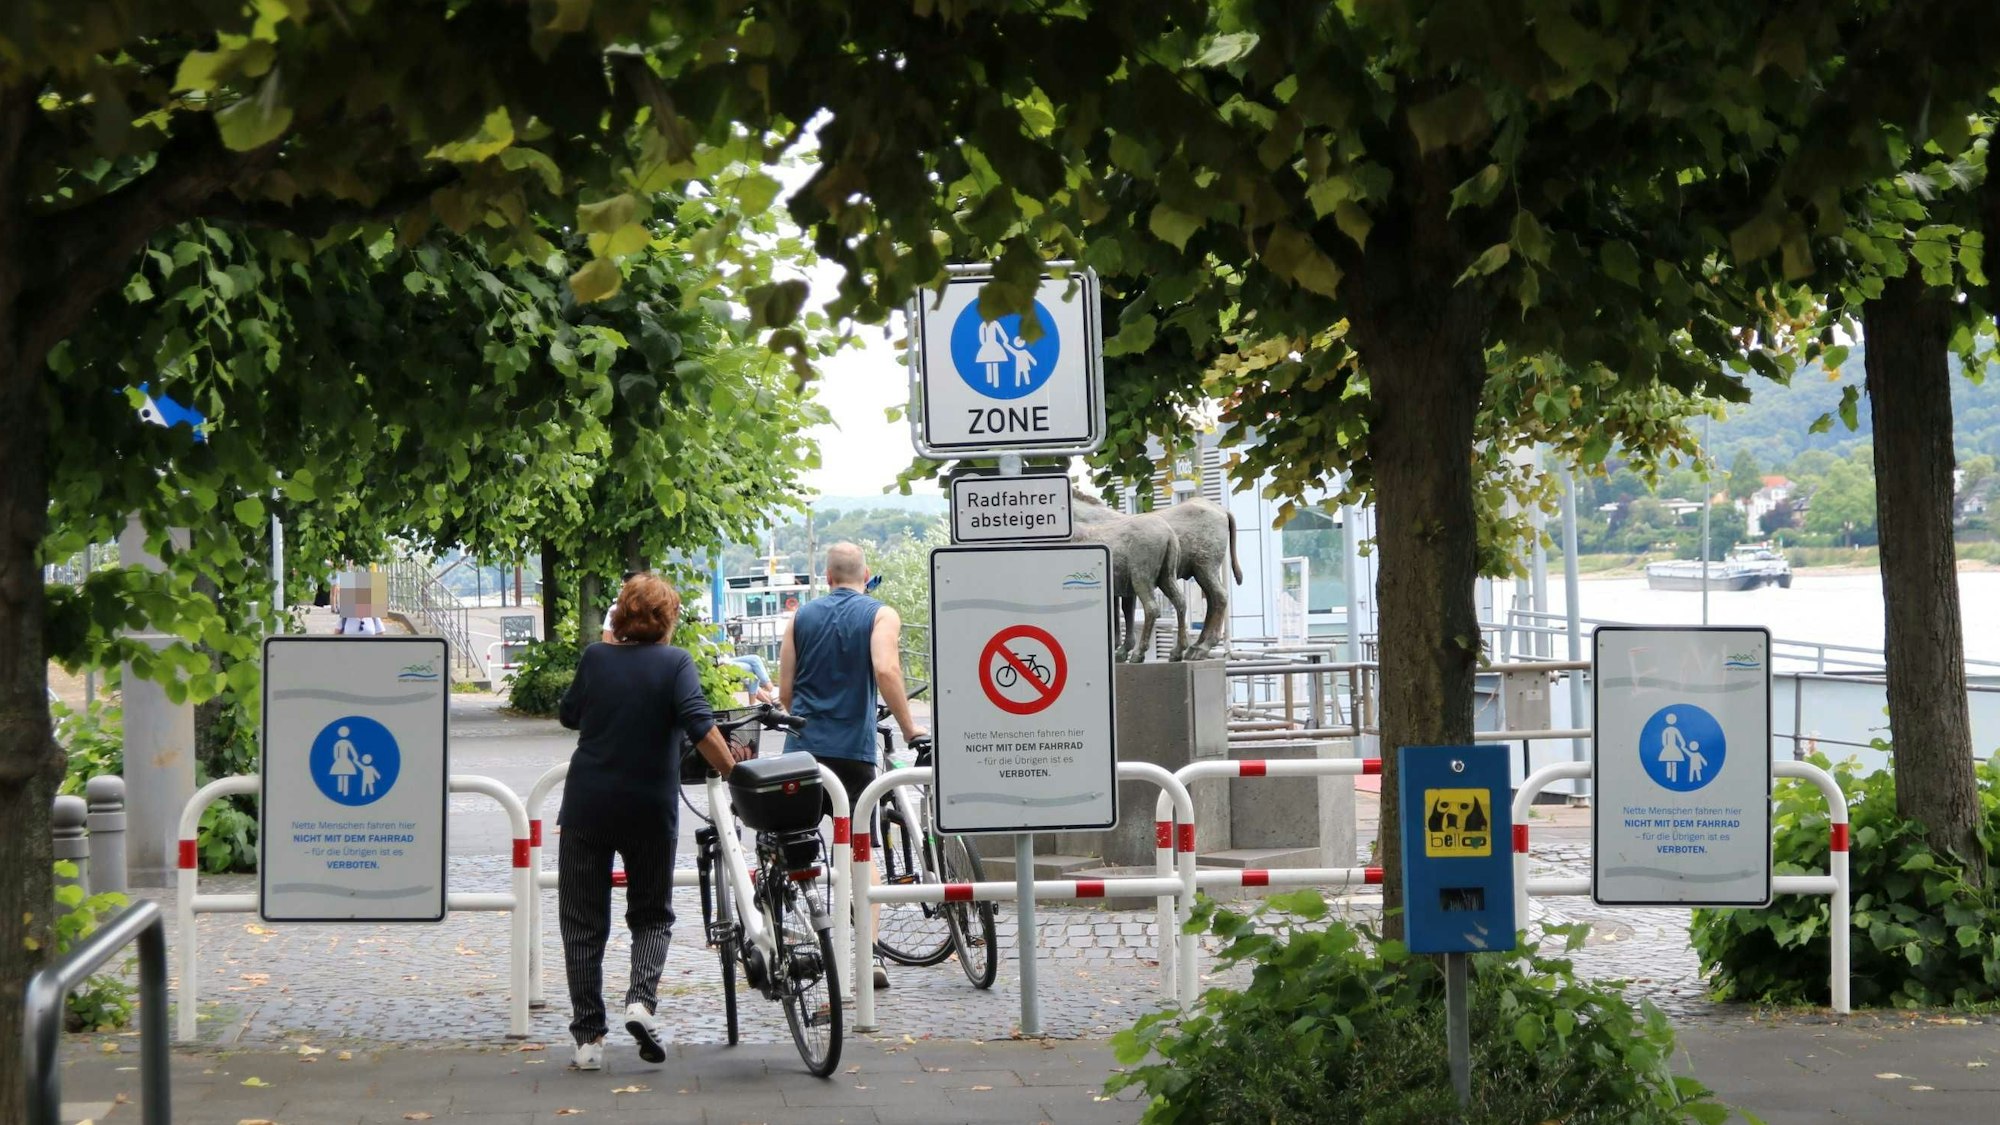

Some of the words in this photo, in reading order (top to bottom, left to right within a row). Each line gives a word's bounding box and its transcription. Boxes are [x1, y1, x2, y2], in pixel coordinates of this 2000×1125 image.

[968, 406, 1049, 434] ZONE
[968, 491, 1056, 507] Radfahrer
[971, 512, 1056, 529] absteigen
[964, 731, 988, 739] Nette
[990, 730, 1035, 739] Menschen
[1037, 729, 1066, 738] fahren
[1068, 728, 1085, 737] hier
[966, 744, 993, 753] NICHT
[996, 744, 1013, 752] MIT
[1015, 743, 1037, 751] DEM
[1039, 742, 1083, 750] FAHRRAD
[984, 757, 996, 766] für
[999, 756, 1012, 765] die
[1015, 755, 1048, 767] Übrigen
[1050, 755, 1061, 764] ist
[1000, 769, 1051, 778] VERBOTEN.
[1623, 807, 1646, 815] Nette
[1648, 807, 1693, 817] Menschen
[1695, 807, 1723, 815] fahren
[1725, 807, 1742, 815] hier
[292, 821, 317, 830] Nette
[319, 821, 365, 830] Menschen
[367, 821, 397, 830] fahren
[399, 821, 416, 830] hier
[1624, 820, 1652, 828] NICHT
[1654, 820, 1671, 828] MIT
[1673, 820, 1694, 828] DEM
[1696, 820, 1740, 828] FAHRRAD
[293, 834, 321, 842] NICHT
[324, 834, 342, 842] MIT
[344, 834, 366, 842] DEM
[368, 834, 414, 842] FAHRRAD
[1642, 833, 1655, 841] für
[1657, 833, 1670, 841] die
[1672, 832, 1705, 844] Übrigen
[1707, 833, 1718, 841] ist
[312, 847, 324, 856] für
[327, 847, 341, 856] die
[343, 846, 377, 859] Übrigen
[380, 847, 392, 856] ist
[1657, 845, 1708, 854] VERBOTEN.
[327, 860, 380, 870] VERBOTEN.
